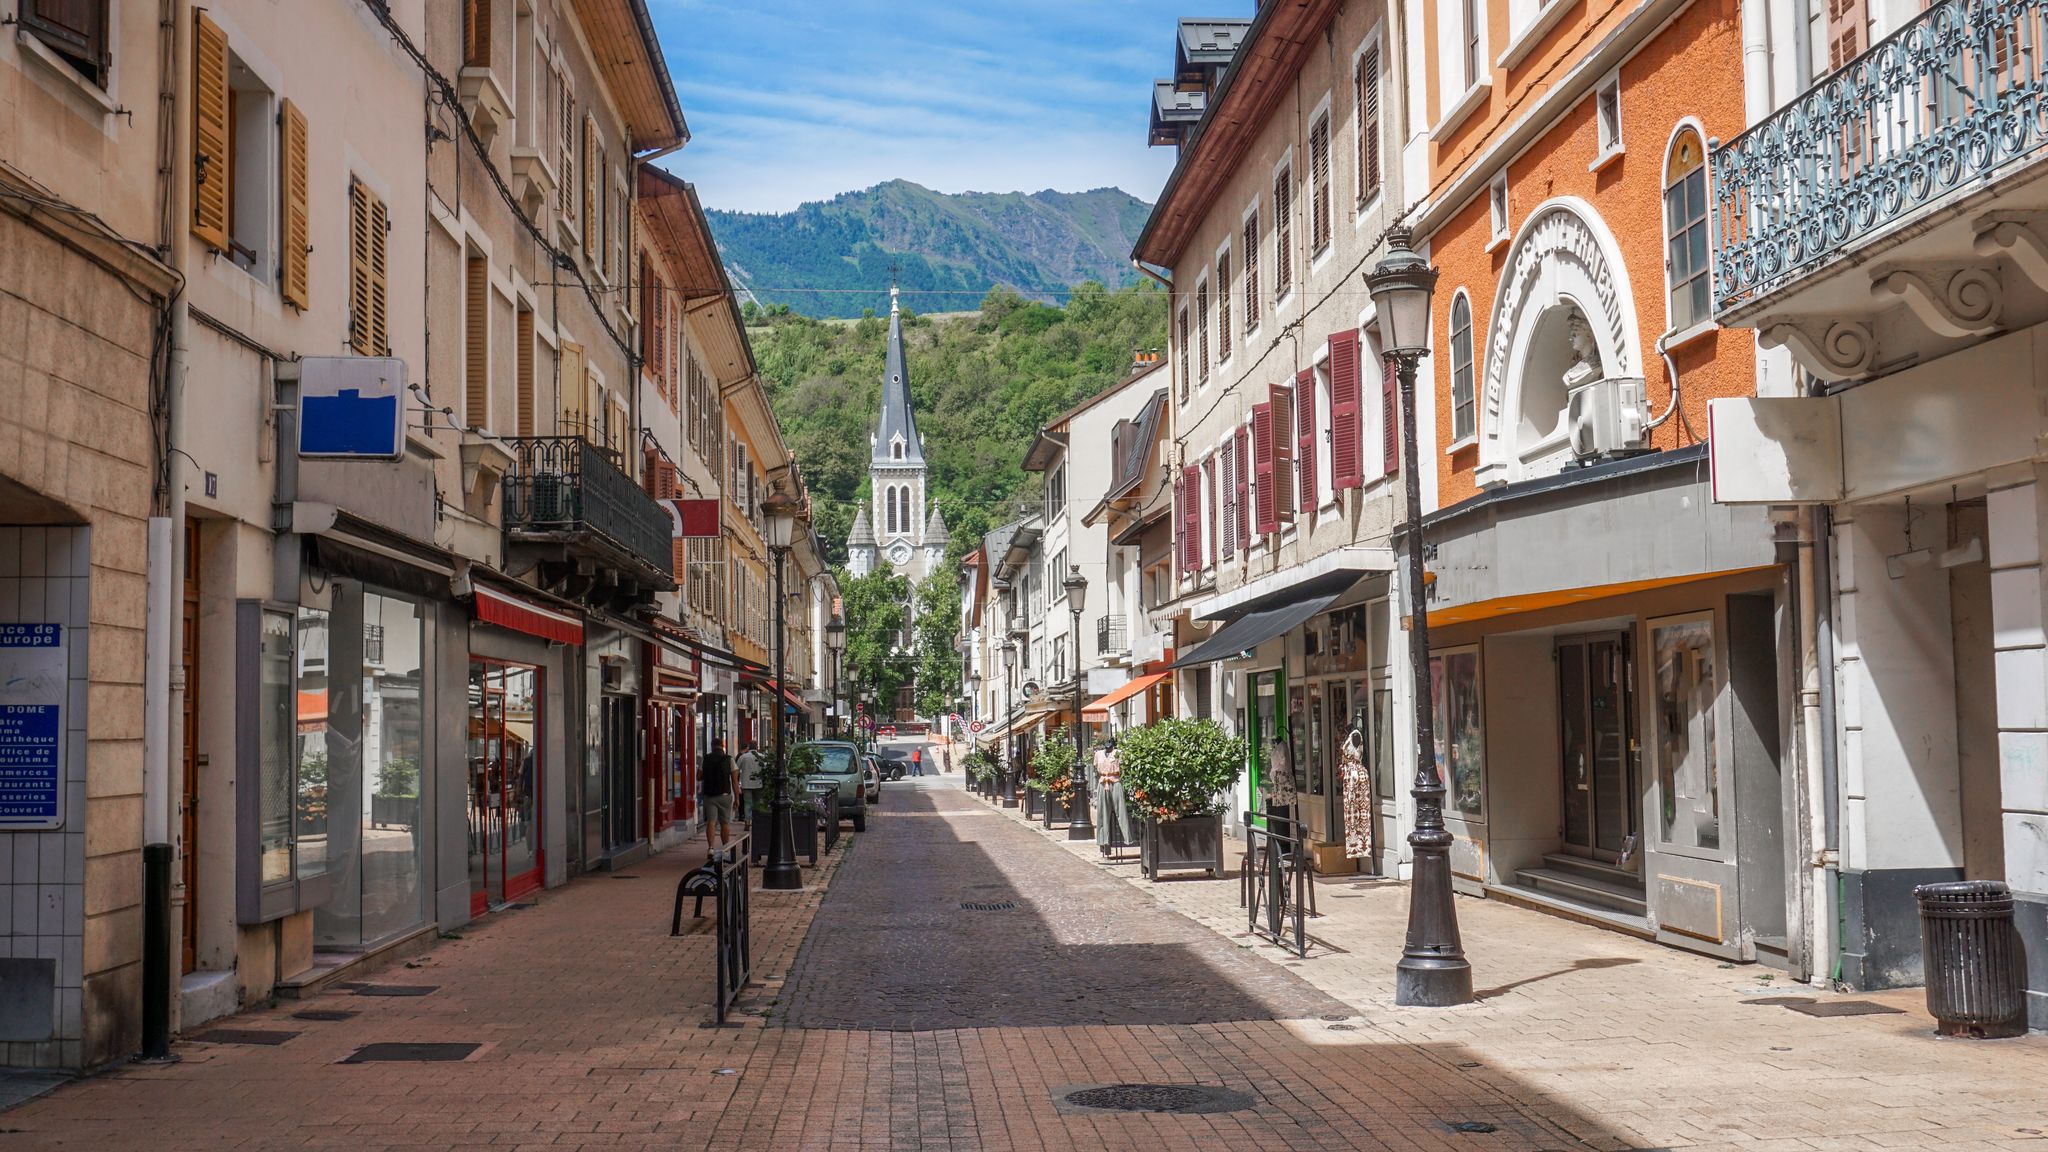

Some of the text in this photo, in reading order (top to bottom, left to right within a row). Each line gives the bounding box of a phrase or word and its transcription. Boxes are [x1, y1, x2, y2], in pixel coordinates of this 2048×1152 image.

[34, 624, 54, 635] de
[0, 635, 52, 646] urope
[7, 705, 46, 714] DOME
[36, 748, 50, 756] de
